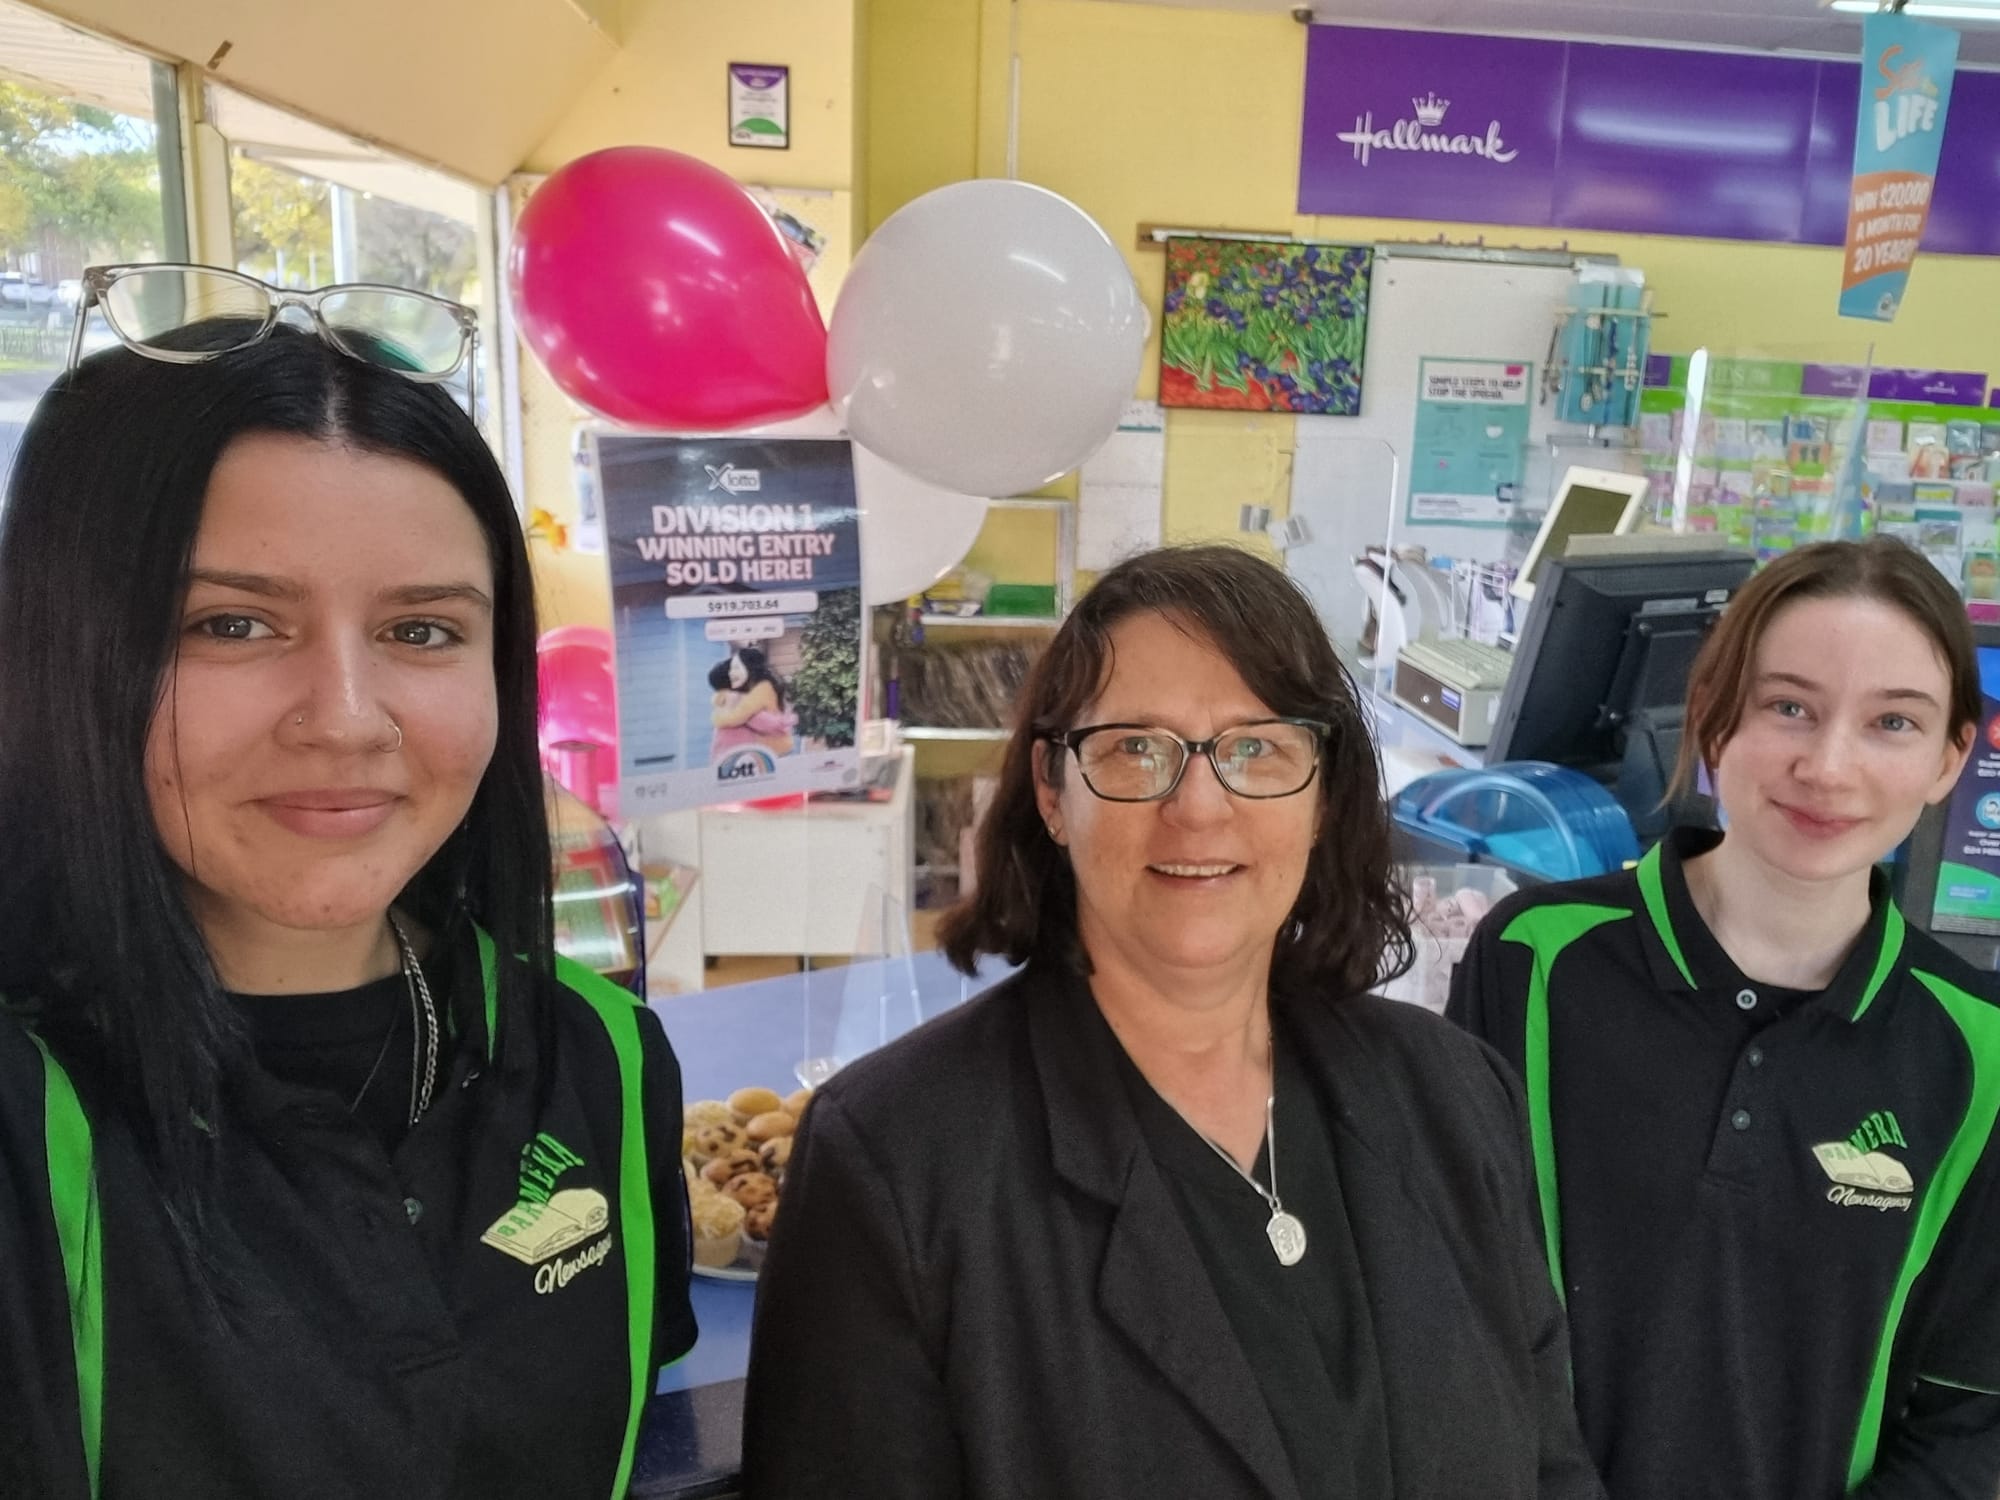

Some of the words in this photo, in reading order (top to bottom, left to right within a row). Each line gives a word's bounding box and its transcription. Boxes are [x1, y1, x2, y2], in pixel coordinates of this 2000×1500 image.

[1336, 111, 1519, 167] Hallmark
[1874, 94, 1938, 152] LIFE
[652, 504, 796, 535] DIVISION
[799, 503, 817, 532] 1
[636, 534, 755, 561] WINNING
[758, 533, 836, 558] ENTRY
[666, 560, 738, 586] SOLD
[741, 558, 813, 582] HERE!
